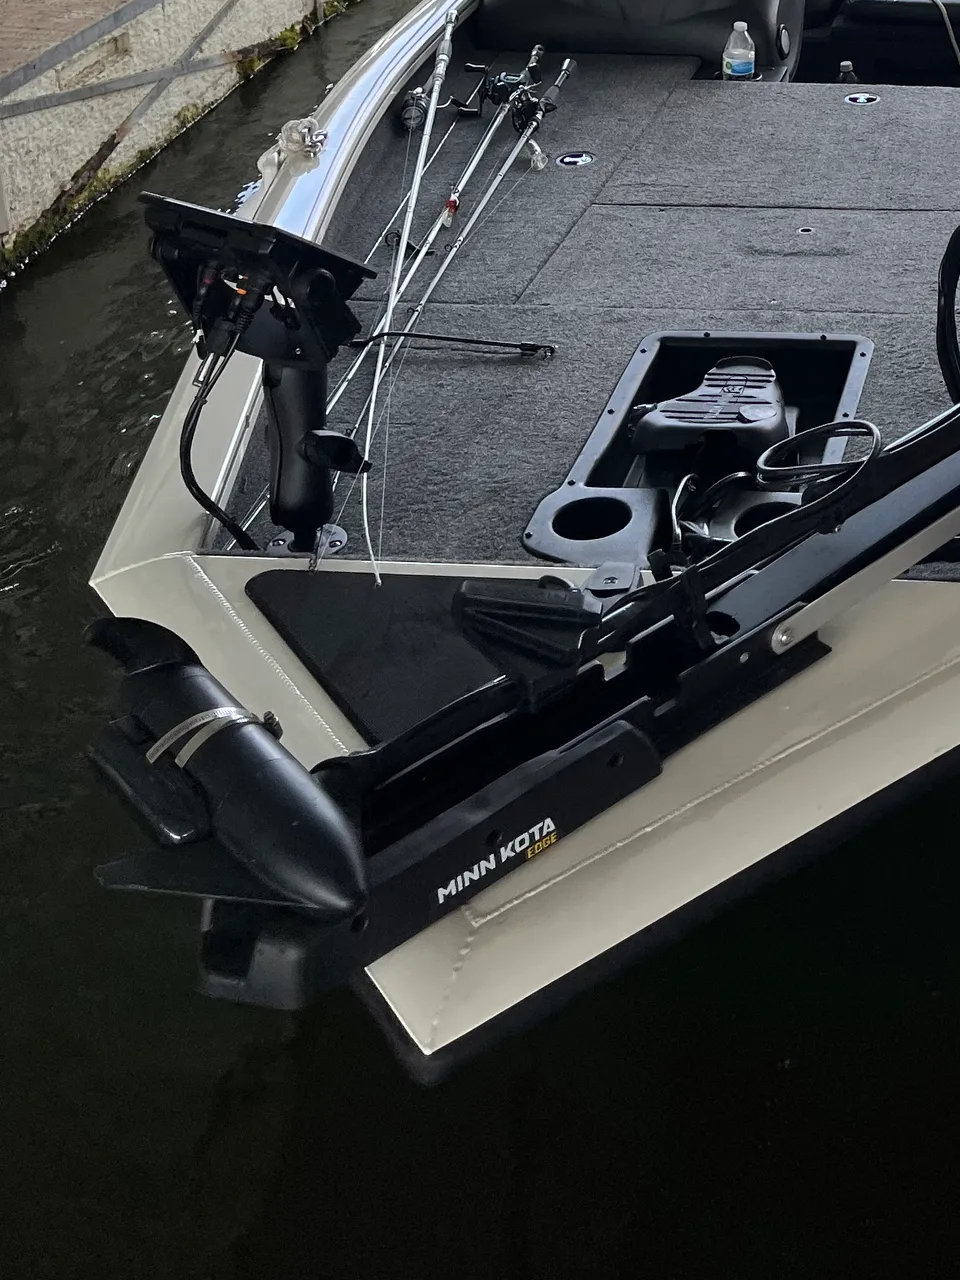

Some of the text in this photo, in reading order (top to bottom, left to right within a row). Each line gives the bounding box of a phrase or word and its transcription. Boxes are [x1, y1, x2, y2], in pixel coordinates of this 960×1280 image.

[437, 817, 556, 904] MINN KOTA
[527, 831, 558, 859] EDGE
